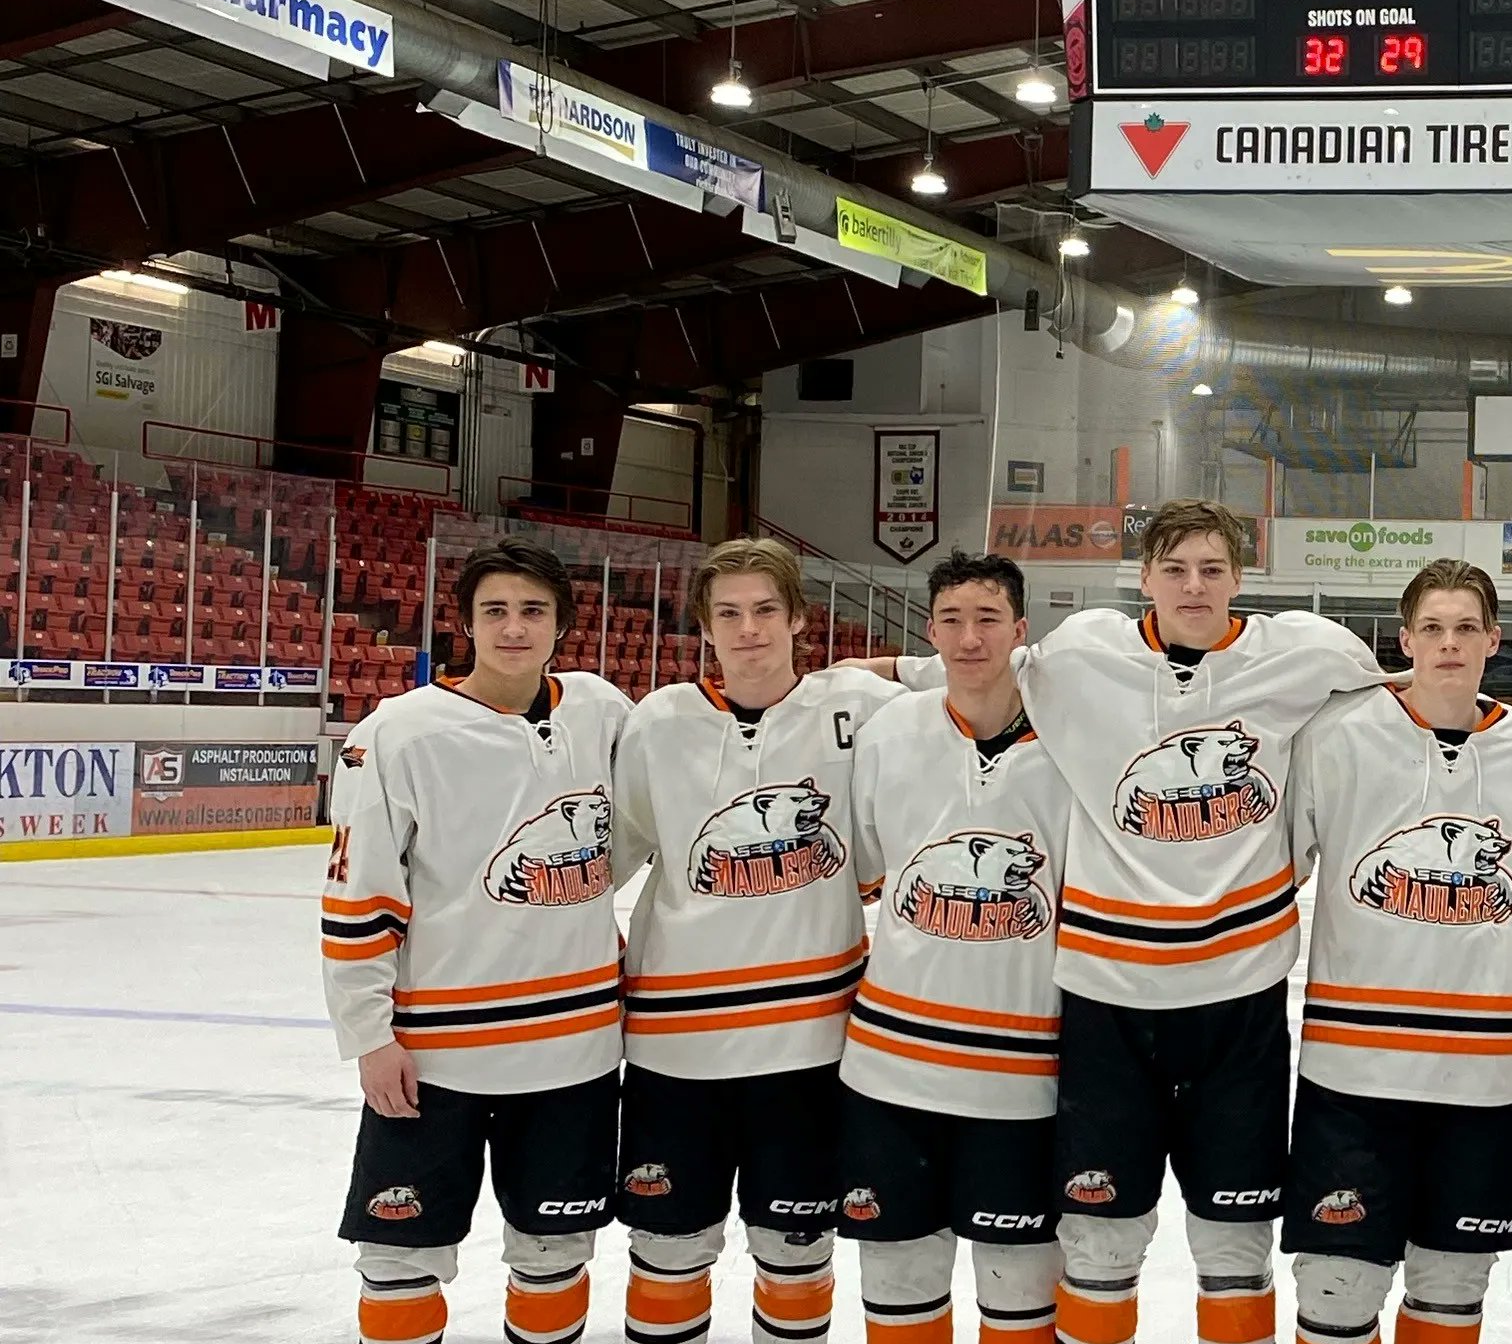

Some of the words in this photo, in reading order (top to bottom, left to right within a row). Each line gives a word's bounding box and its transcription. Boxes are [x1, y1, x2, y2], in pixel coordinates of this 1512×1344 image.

[1308, 9, 1352, 28] SHOTS
[1356, 8, 1376, 27] ON
[1379, 7, 1416, 26] GOAL
[1305, 37, 1344, 76] 32
[1380, 35, 1422, 74] 29
[1216, 124, 1412, 164] CANADIAN
[1426, 123, 1511, 163] TIRE
[245, 302, 276, 331] M
[95, 370, 113, 387] SGI
[114, 372, 155, 396] Salvage
[525, 362, 549, 389] N
[887, 513, 927, 522] 2014
[994, 522, 1086, 549] HAAS
[1304, 554, 1341, 570] Going
[1345, 555, 1365, 568] the
[1368, 555, 1402, 568] extra
[833, 710, 853, 750] C
[146, 756, 178, 781] AS
[192, 749, 240, 764] ASPHALT
[242, 749, 307, 763] PRODUCTION
[309, 749, 317, 763] &
[219, 767, 291, 782] INSTALLATION
[20, 813, 110, 836] WEEK
[1139, 784, 1254, 842] MAULERS
[711, 840, 826, 898] MAULERS
[1383, 868, 1500, 923] MAULERS
[914, 884, 1030, 941] MAULERS
[538, 1196, 606, 1216] CCM
[769, 1198, 837, 1216] CCM
[1212, 1187, 1281, 1206] CCM
[971, 1211, 1045, 1230] CCM
